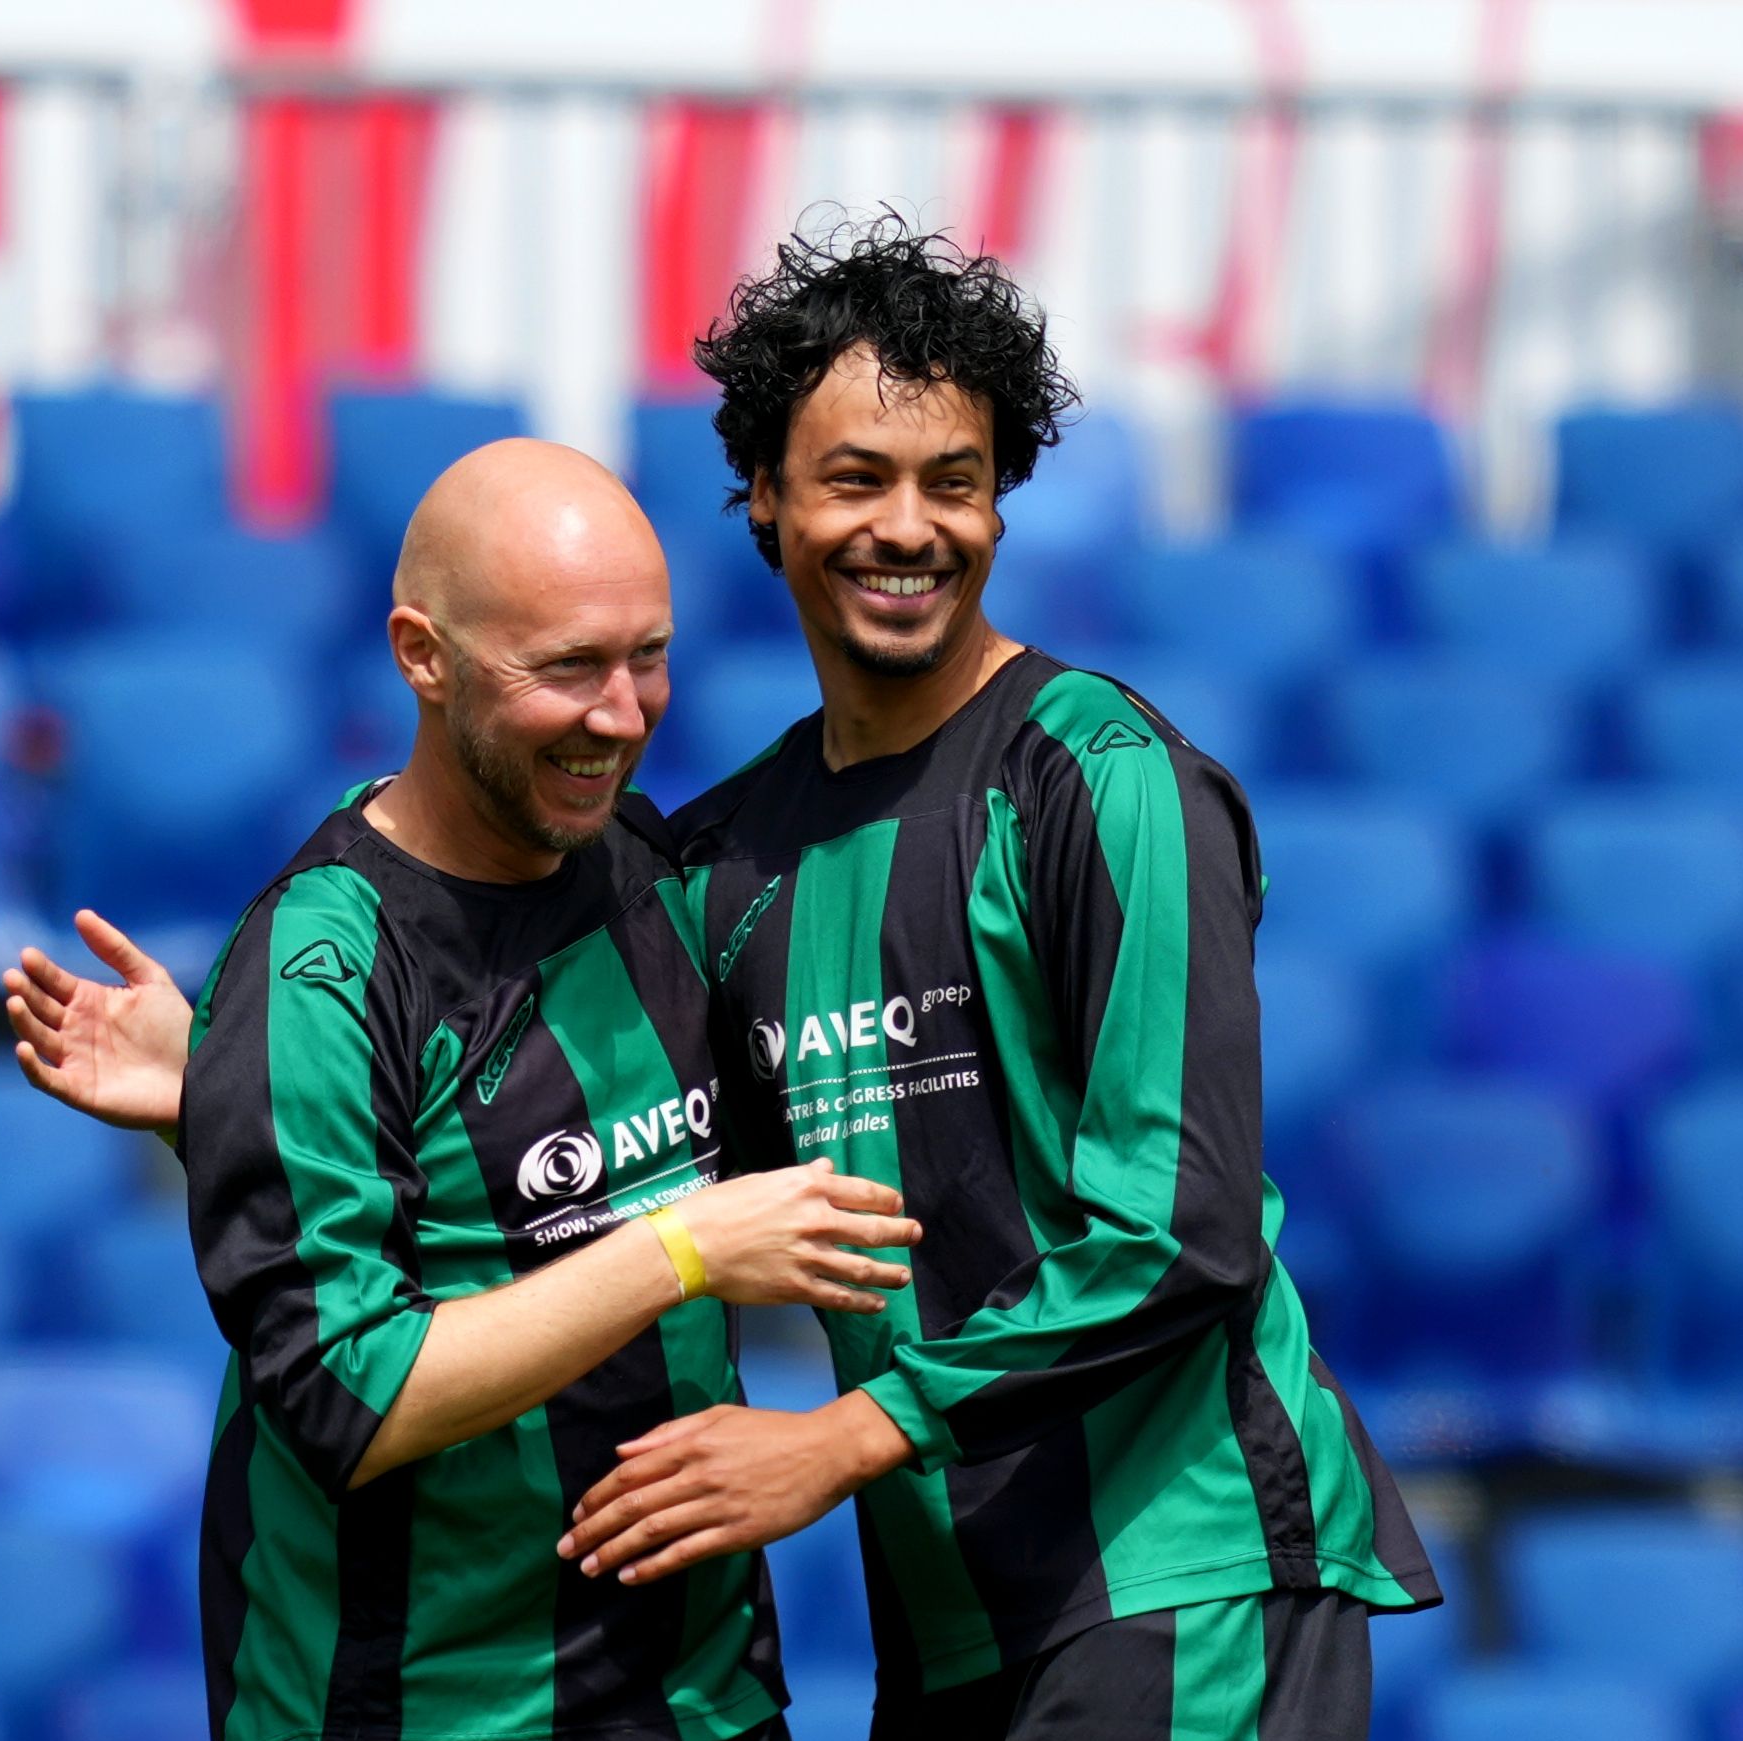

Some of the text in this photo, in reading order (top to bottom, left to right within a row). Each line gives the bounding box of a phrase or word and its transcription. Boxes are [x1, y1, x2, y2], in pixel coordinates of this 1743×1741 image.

[796, 983, 971, 1062] AVEQ groep
[815, 1097, 829, 1114] &
[834, 1082, 906, 1112] CGRESS
[908, 1070, 980, 1097] FACILITIES
[612, 1088, 712, 1170] AVEQ
[798, 1121, 839, 1148] rental
[534, 1218, 596, 1247] SHOW,
